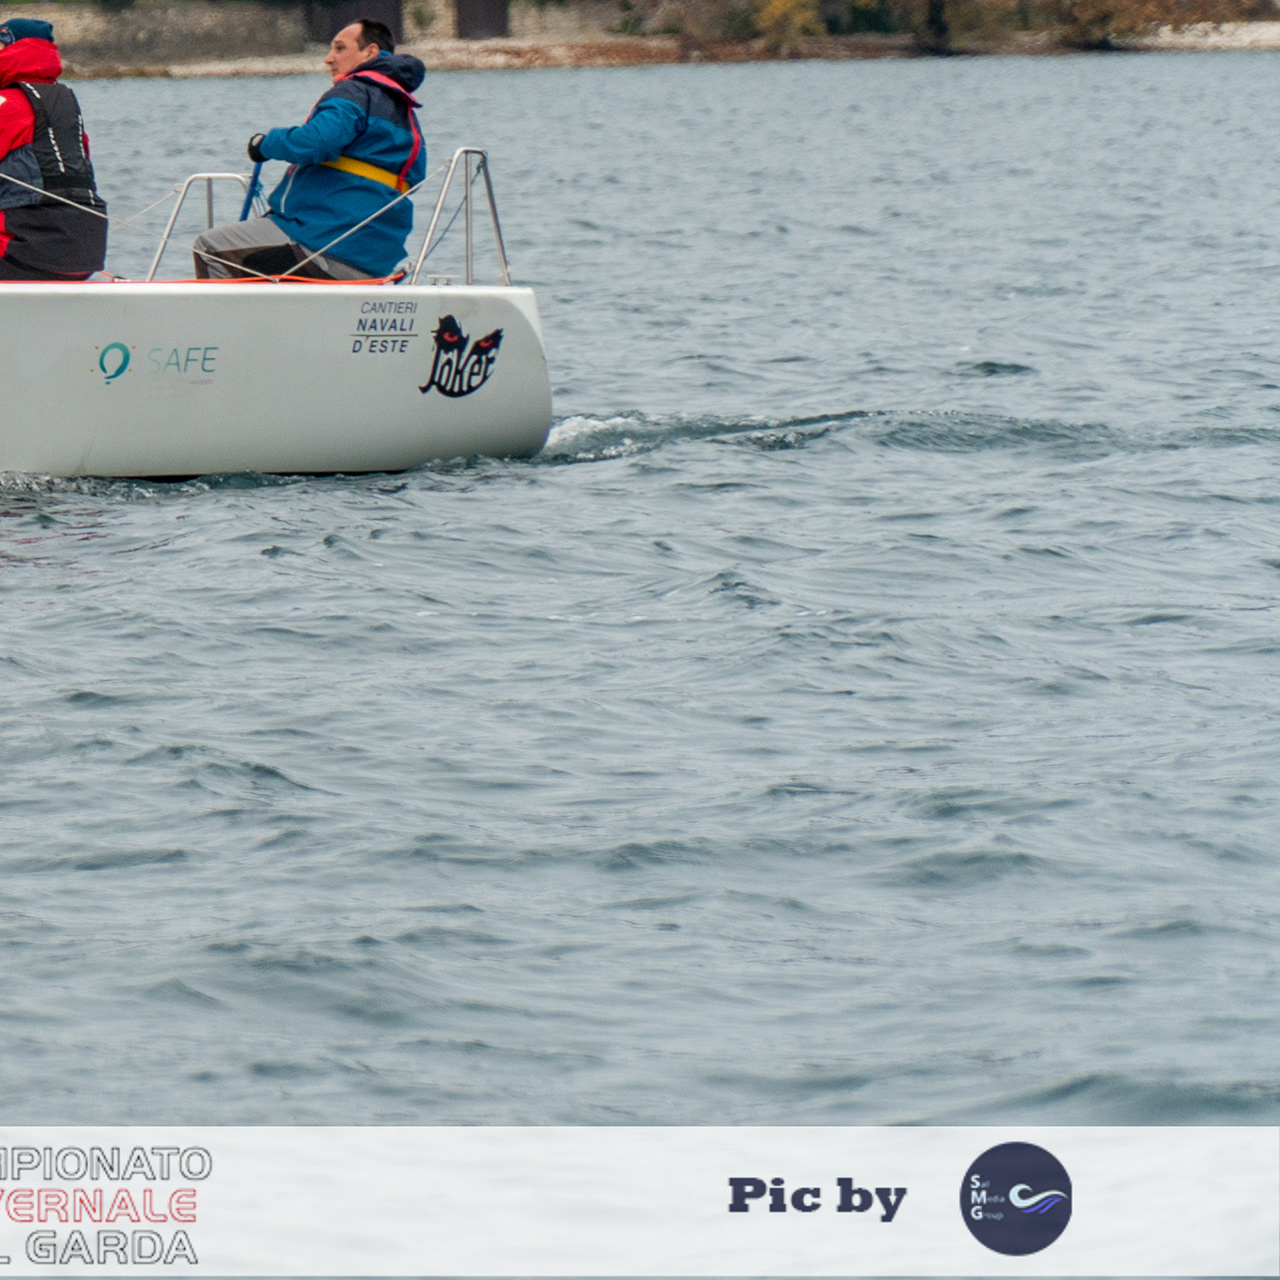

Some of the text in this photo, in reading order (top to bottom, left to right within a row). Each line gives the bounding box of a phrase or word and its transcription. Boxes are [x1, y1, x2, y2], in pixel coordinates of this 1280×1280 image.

[361, 301, 418, 314] CANTIERI
[356, 318, 415, 332] NAVALI
[351, 336, 410, 353] D'ESTE
[147, 346, 219, 375] SAFE
